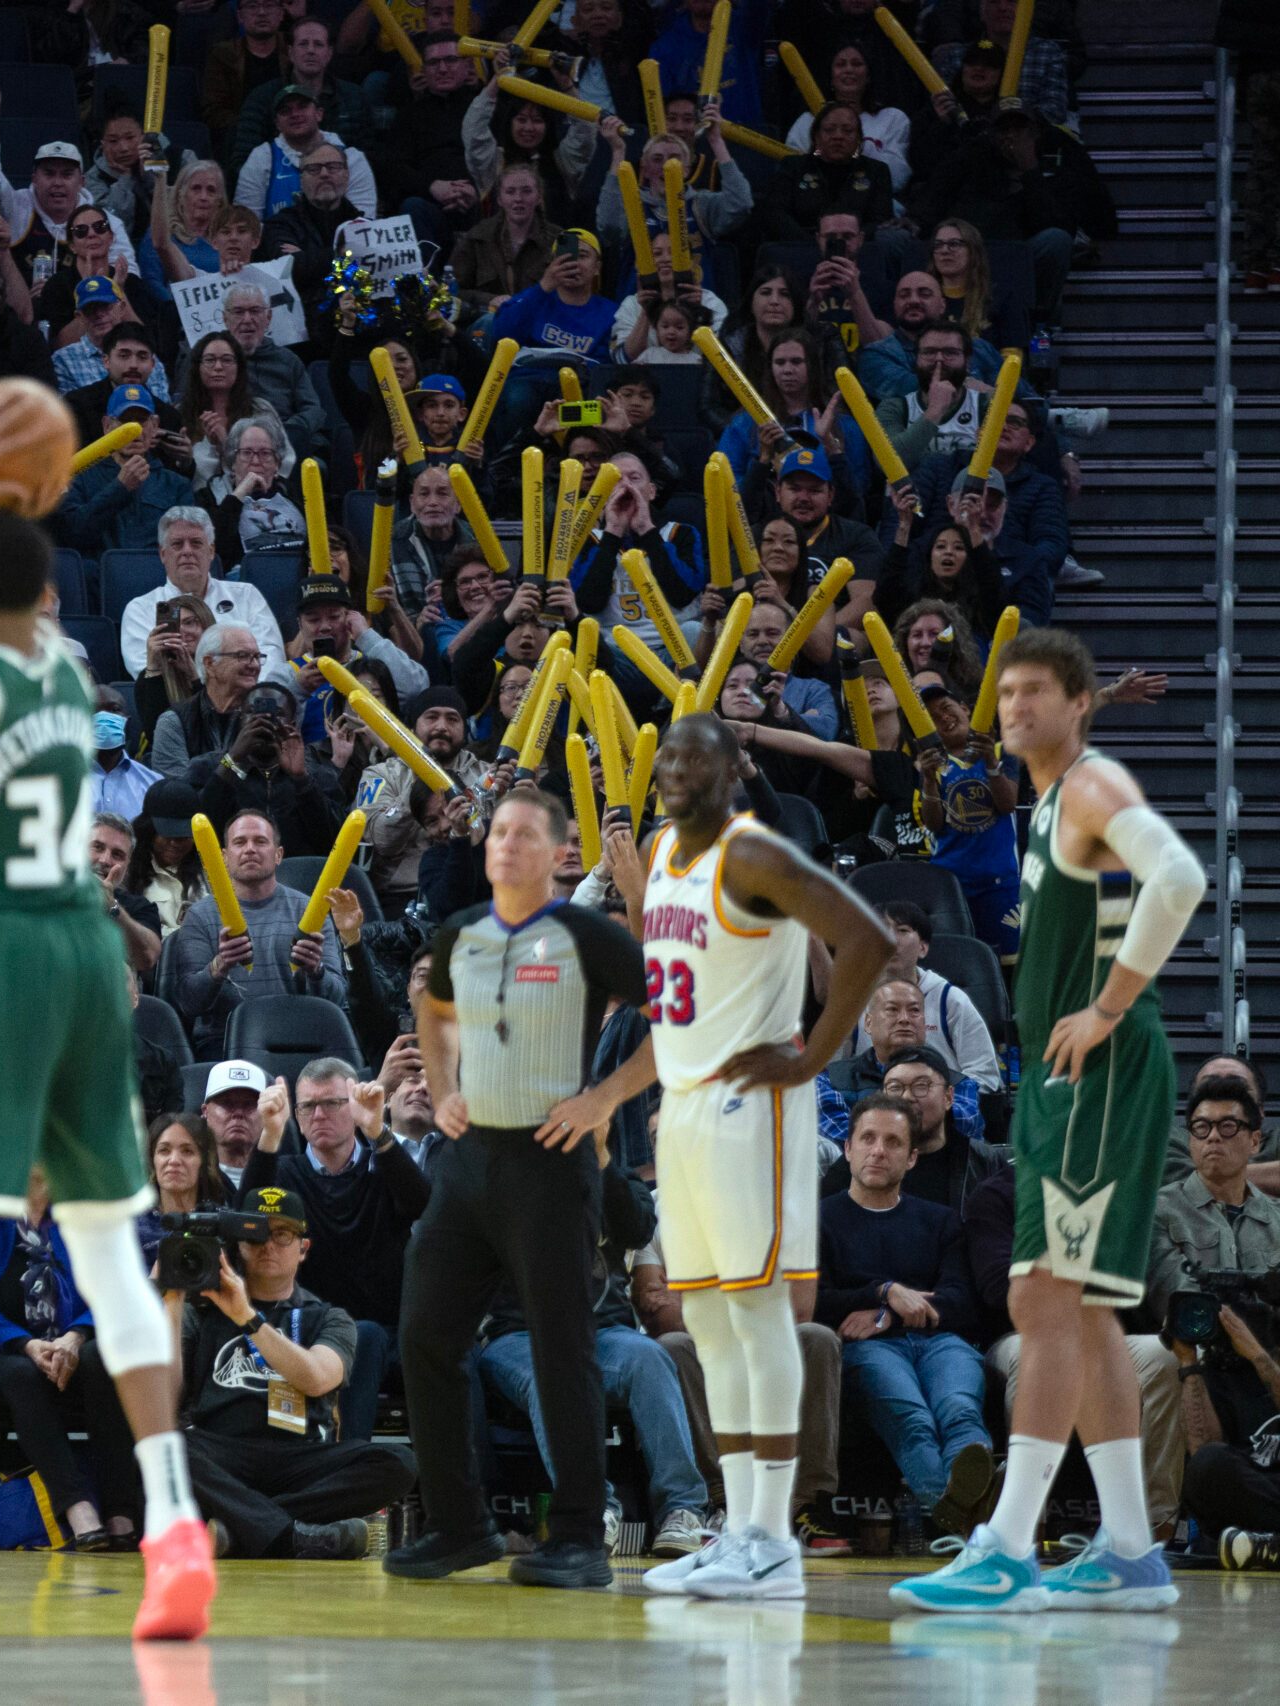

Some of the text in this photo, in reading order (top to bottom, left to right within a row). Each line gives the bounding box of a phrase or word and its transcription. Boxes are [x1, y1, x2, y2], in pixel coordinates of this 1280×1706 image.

[354, 224, 414, 248] TYLER
[541, 323, 594, 351] GSW
[553, 508, 569, 560] WARRIORS
[797, 598, 816, 621] KAISER
[647, 594, 687, 664] KAISER PERMANENTE
[532, 698, 558, 750] WARRIORS
[968, 785, 985, 799] 30
[645, 958, 696, 1026] 23
[258, 1205, 281, 1213] STATE
